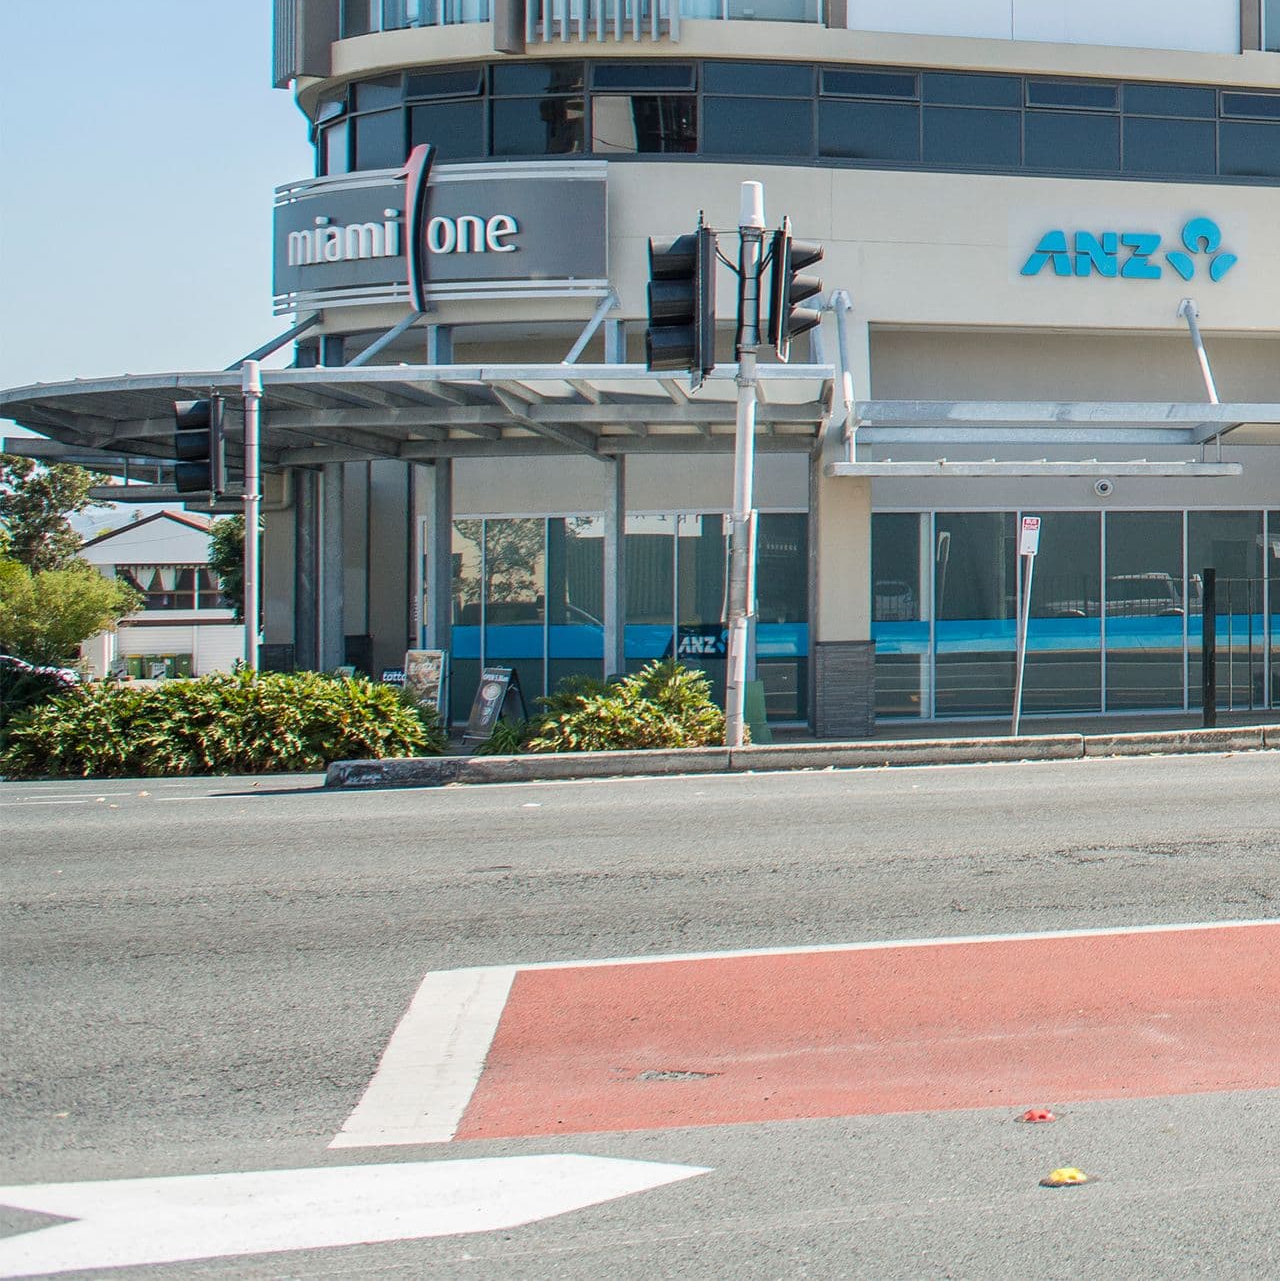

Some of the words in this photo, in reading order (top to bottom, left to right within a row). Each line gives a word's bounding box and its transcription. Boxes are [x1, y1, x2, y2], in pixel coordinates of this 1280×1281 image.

[288, 208, 399, 266] miami
[426, 214, 519, 254] one
[1020, 230, 1162, 280] ANZ
[679, 635, 716, 654] ANZ
